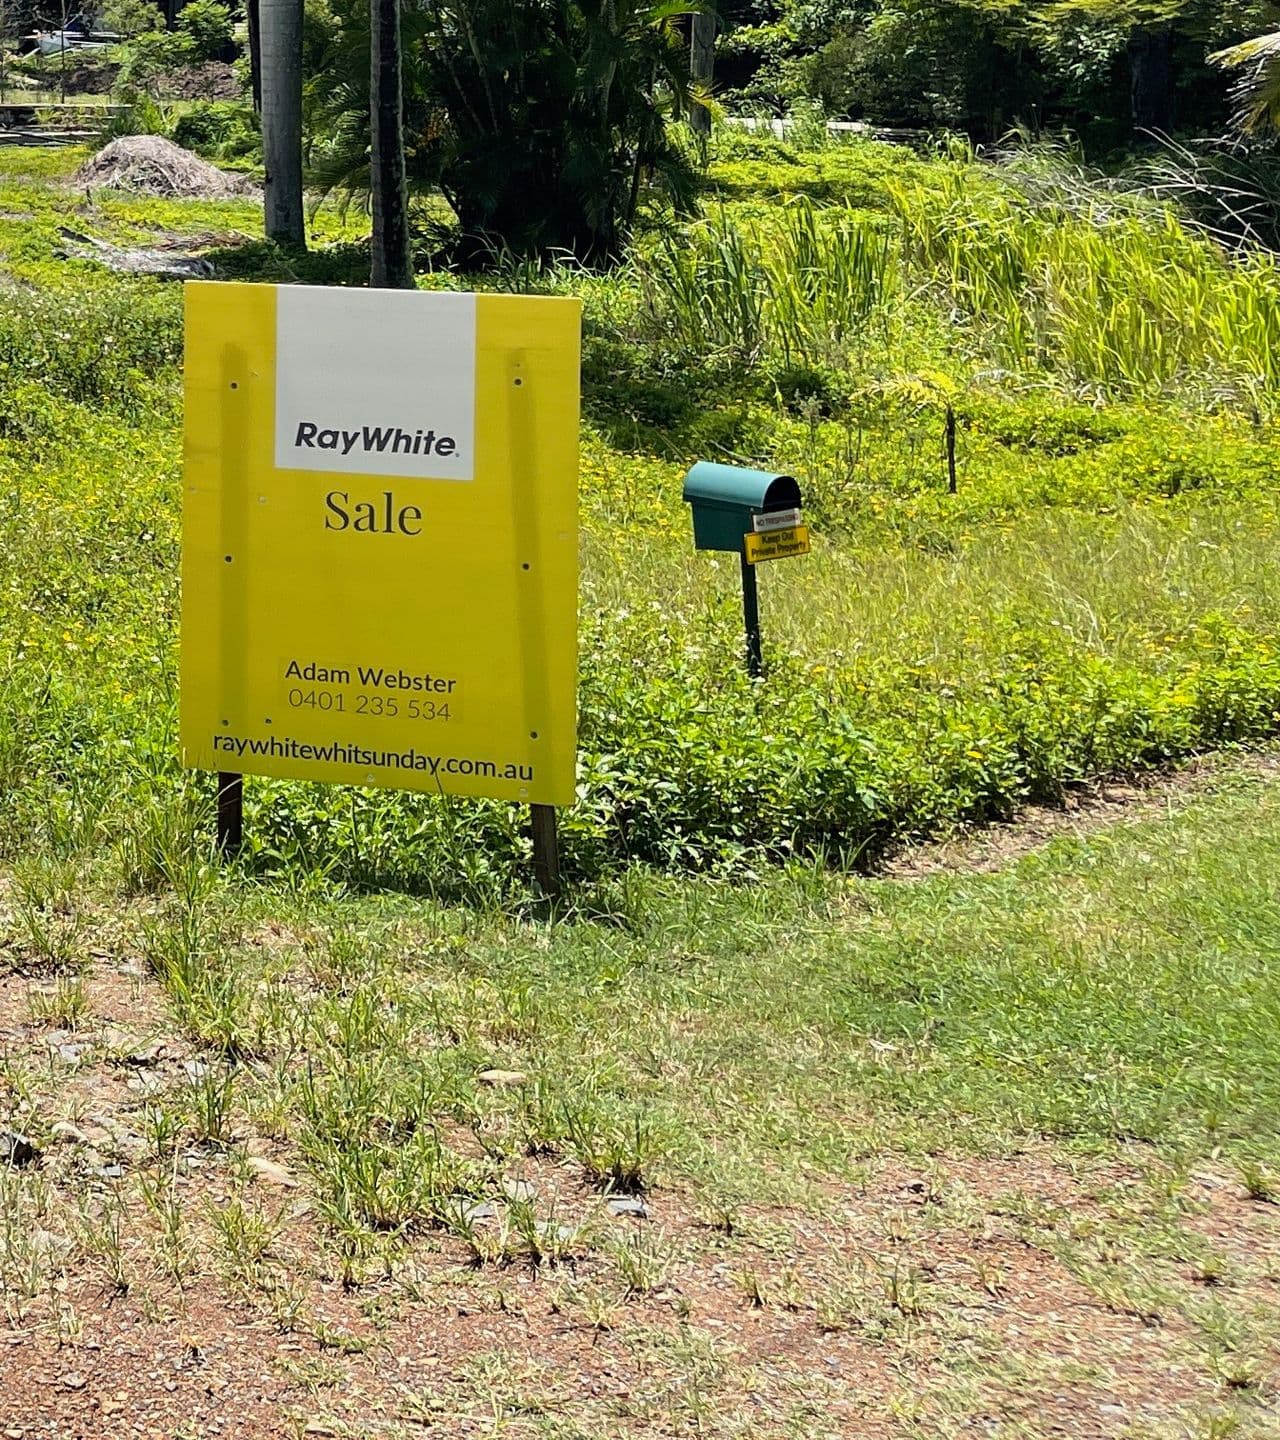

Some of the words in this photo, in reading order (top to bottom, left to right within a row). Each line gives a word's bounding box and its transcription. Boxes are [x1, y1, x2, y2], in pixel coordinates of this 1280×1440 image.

[324, 491, 422, 536] Sale
[285, 660, 350, 685] Adam
[358, 668, 456, 693] Webster
[288, 689, 346, 713] 0401
[355, 696, 399, 719] 235
[407, 700, 451, 722] 534
[213, 732, 534, 781] raywhitewhitsunday.com.au
